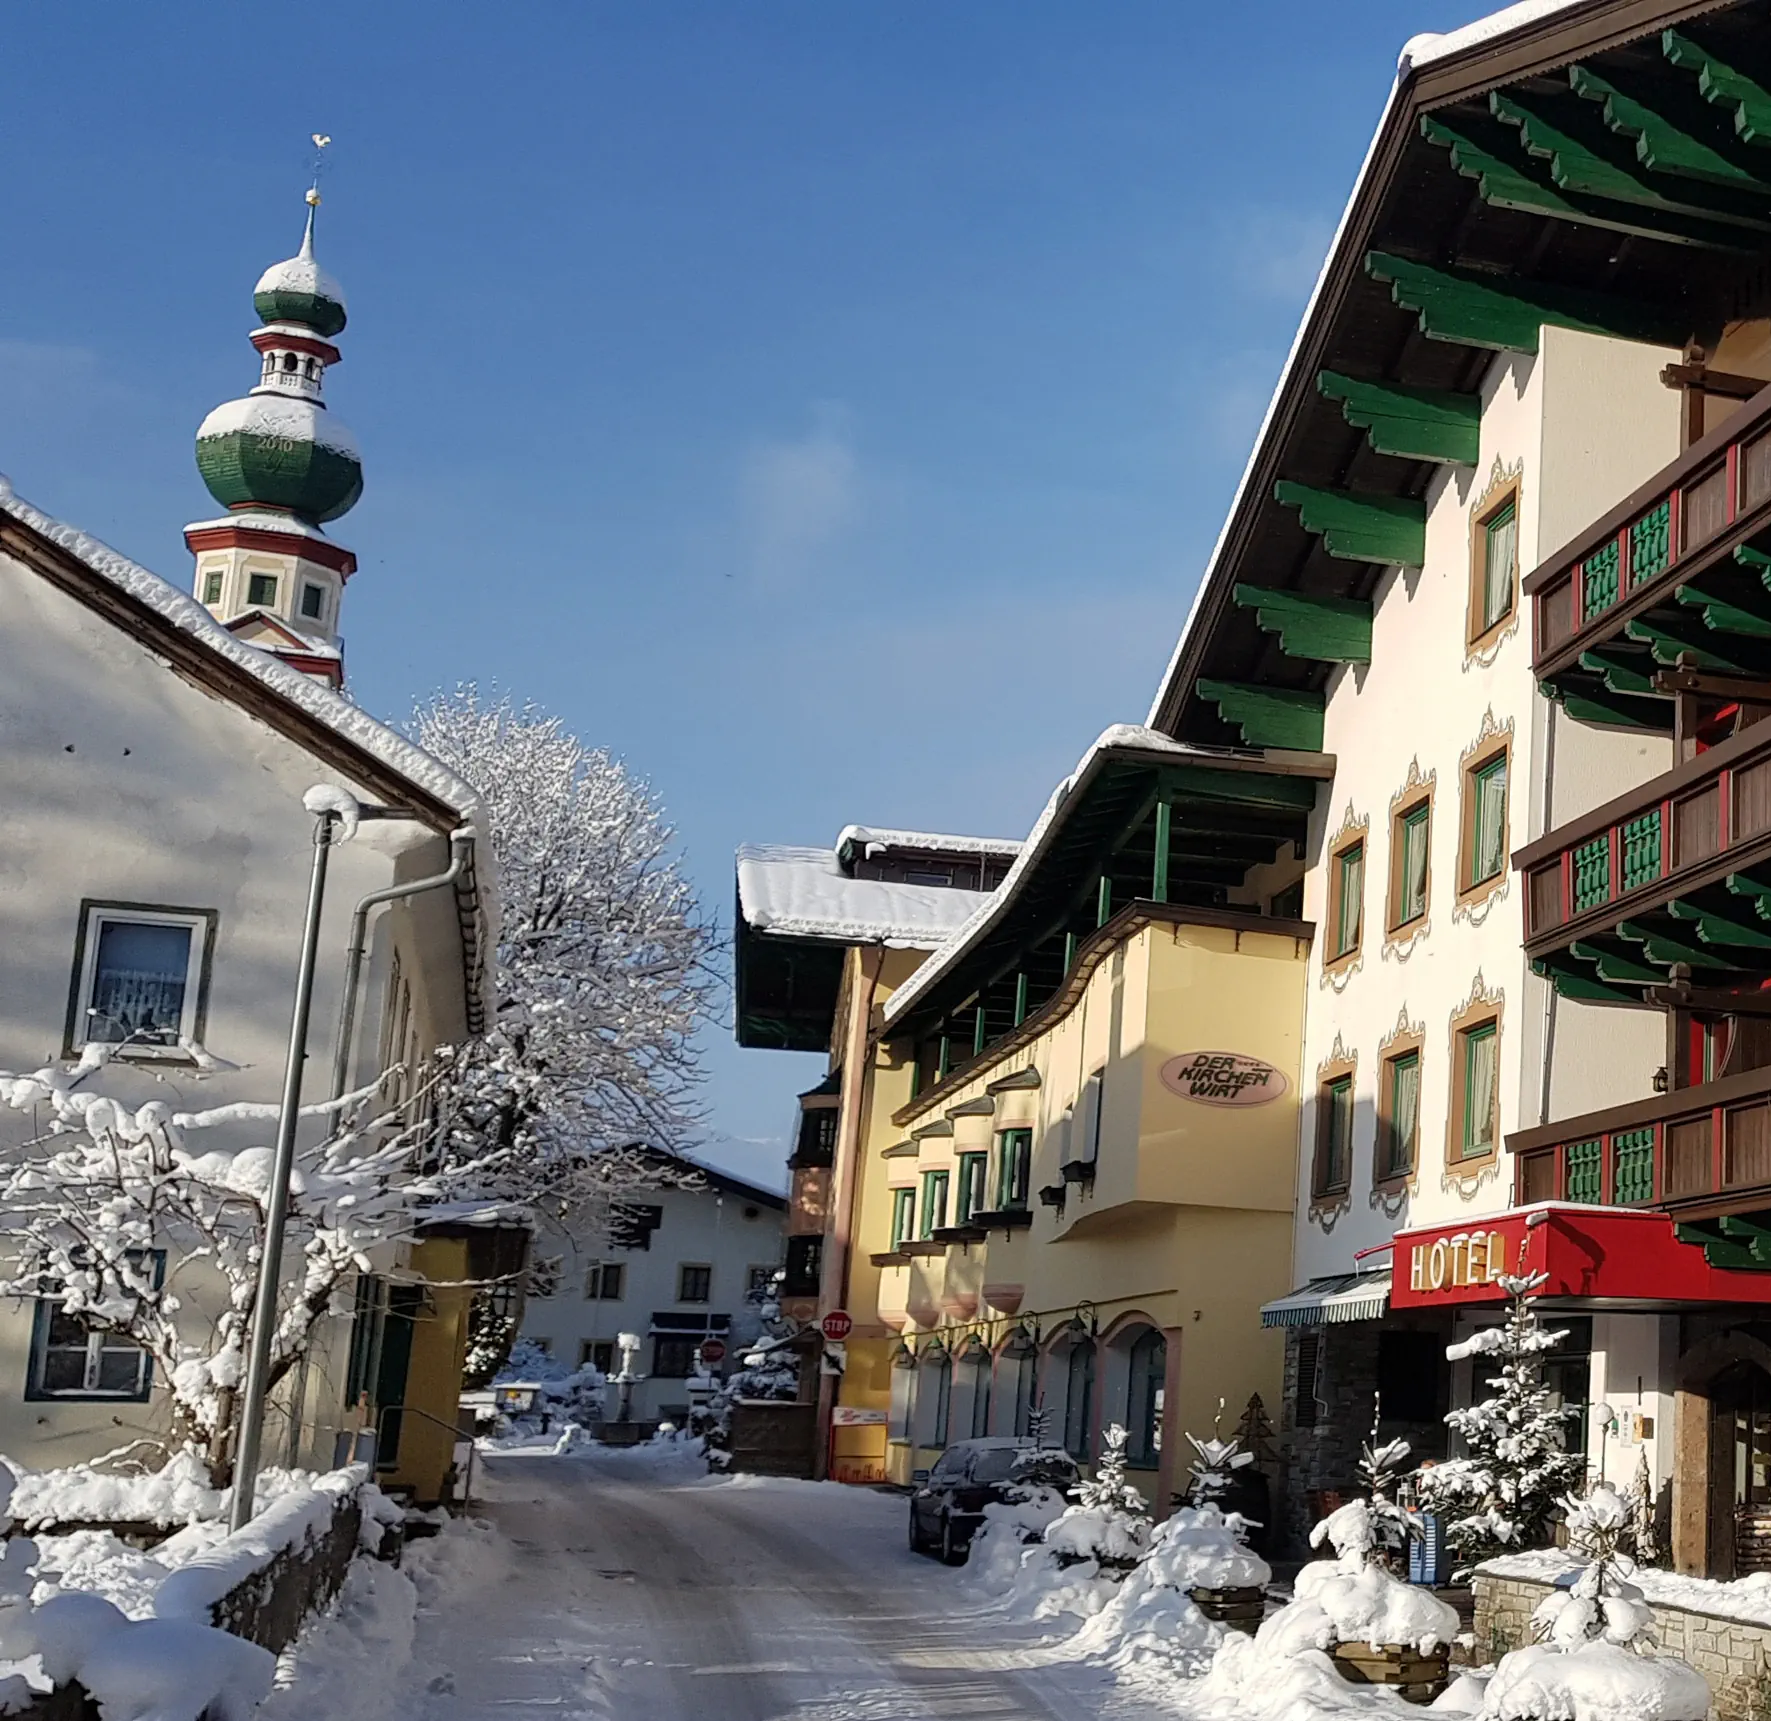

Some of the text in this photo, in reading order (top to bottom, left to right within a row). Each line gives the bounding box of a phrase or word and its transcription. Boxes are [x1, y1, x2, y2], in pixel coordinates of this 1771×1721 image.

[1192, 1055, 1236, 1069] DER
[1178, 1067, 1269, 1086] KIRCHEN
[1189, 1082, 1245, 1099] WIRT
[1410, 1232, 1504, 1291] HOTEL
[823, 1319, 850, 1332] STOP
